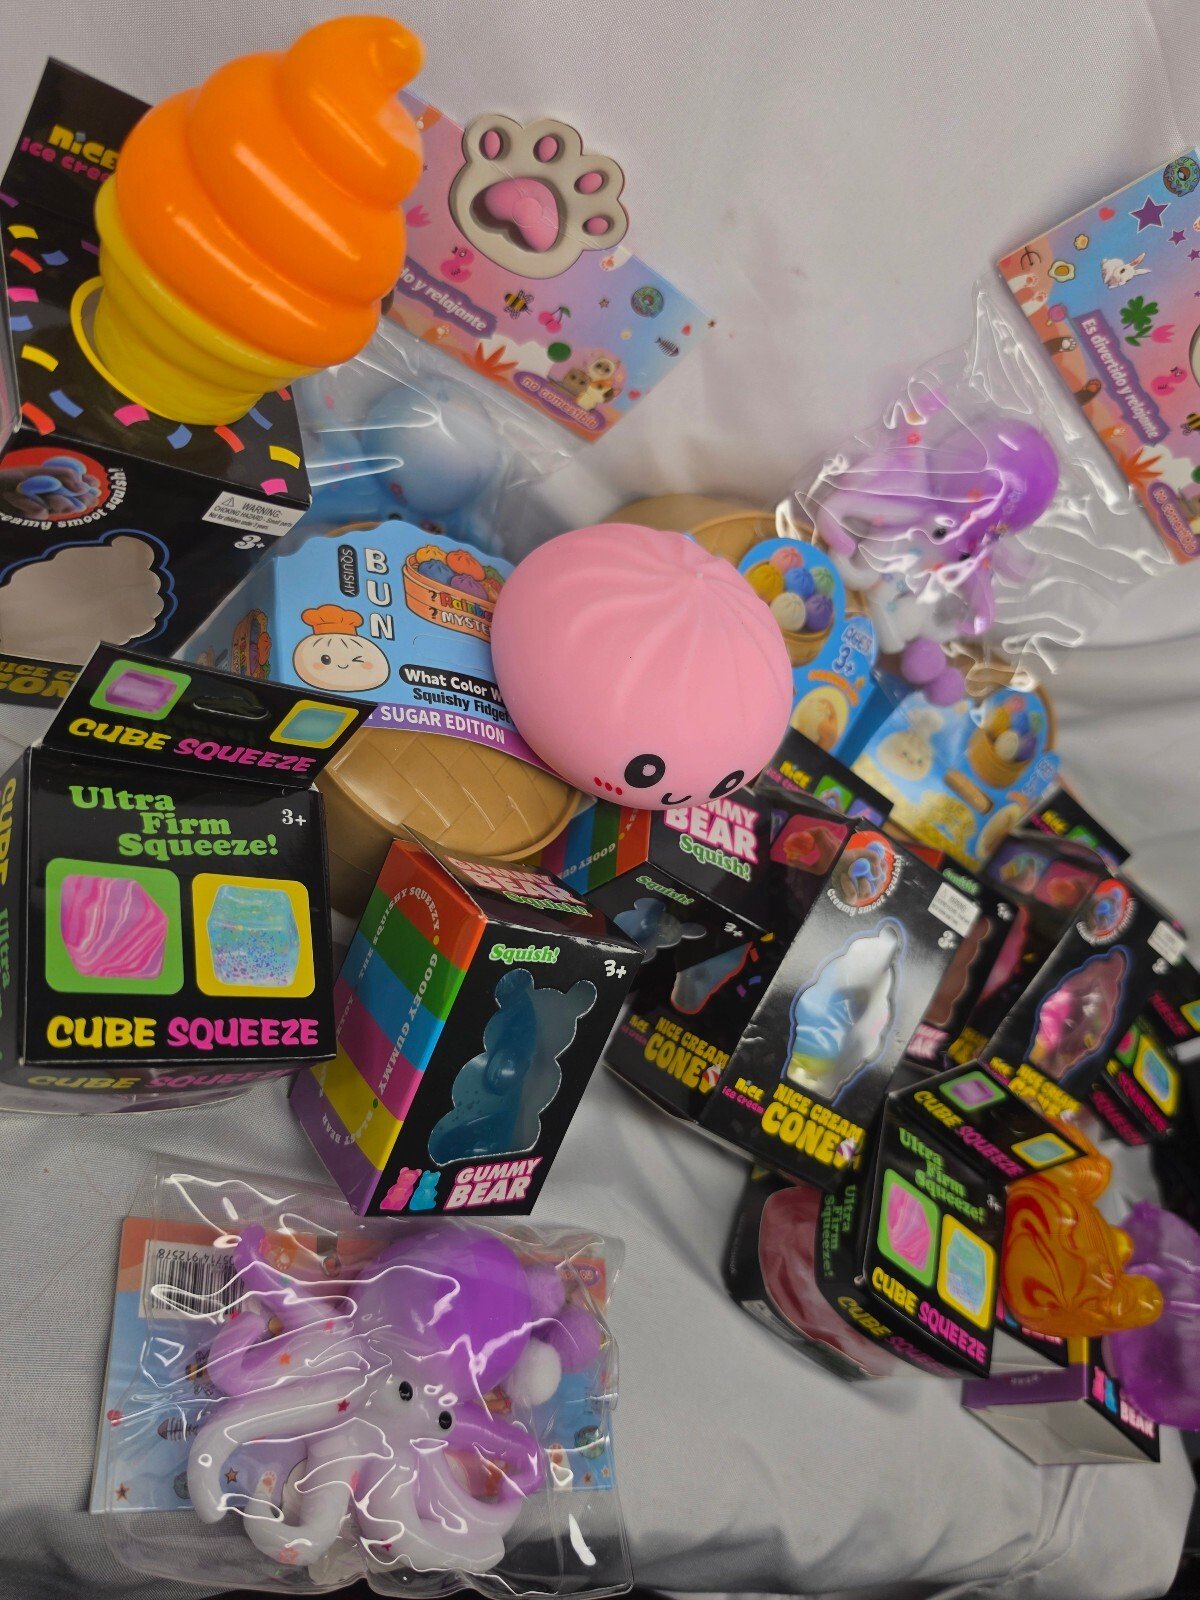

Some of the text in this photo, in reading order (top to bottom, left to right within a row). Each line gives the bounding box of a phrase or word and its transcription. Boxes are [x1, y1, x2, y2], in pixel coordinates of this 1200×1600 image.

[411, 280, 427, 292] y
[424, 287, 487, 332] relajante
[520, 376, 541, 392] no
[1081, 318, 1160, 439] Es divertido y relajante
[105, 467, 128, 511] squish!
[213, 505, 241, 517] CHOKING
[240, 512, 264, 522] HAZARD
[242, 502, 283, 519] WARNING:
[234, 534, 266, 550] 3+
[340, 549, 357, 596] SQUISHY
[404, 668, 447, 688] What
[450, 676, 488, 698] Color
[412, 687, 470, 713] Squishy
[380, 705, 505, 745] SUGAR EDITION
[68, 717, 316, 772] CUBE SQUEEZE
[69, 785, 177, 812] Ultra
[140, 812, 232, 836] Firm
[281, 809, 307, 827] 3+
[664, 805, 759, 865] BEAR
[118, 833, 280, 862] Squeeze!
[678, 833, 751, 883] Squish!
[443, 855, 557, 887] GUMMY
[462, 869, 588, 906] BEAR
[408, 886, 440, 931] SQUEEZY
[635, 875, 695, 906] Squish!
[723, 922, 744, 937] 3+
[488, 943, 561, 965] Squish!
[603, 959, 627, 979] 3+
[46, 1015, 157, 1049] CUBE
[167, 1016, 319, 1050] SQUEEZE
[378, 953, 438, 1096] GOOEY GUMMY
[655, 1016, 684, 1042] NICE
[681, 1031, 731, 1070] CREAM
[26, 1074, 142, 1090] CUBE
[772, 1082, 867, 1143] NICE CREAM
[899, 1127, 945, 1169] Ultra
[913, 1090, 964, 1129] CUBE
[955, 1125, 1026, 1178] SQUEEZE
[454, 1156, 544, 1185] GUMMY
[443, 1175, 533, 1211] BEAR
[842, 1184, 857, 1232] Ultra
[914, 1168, 986, 1224] Squeeze!
[157, 1248, 199, 1263] 912578
[837, 1296, 892, 1337] CUBE
[871, 1266, 987, 1365] CUBE SQUEEZE
